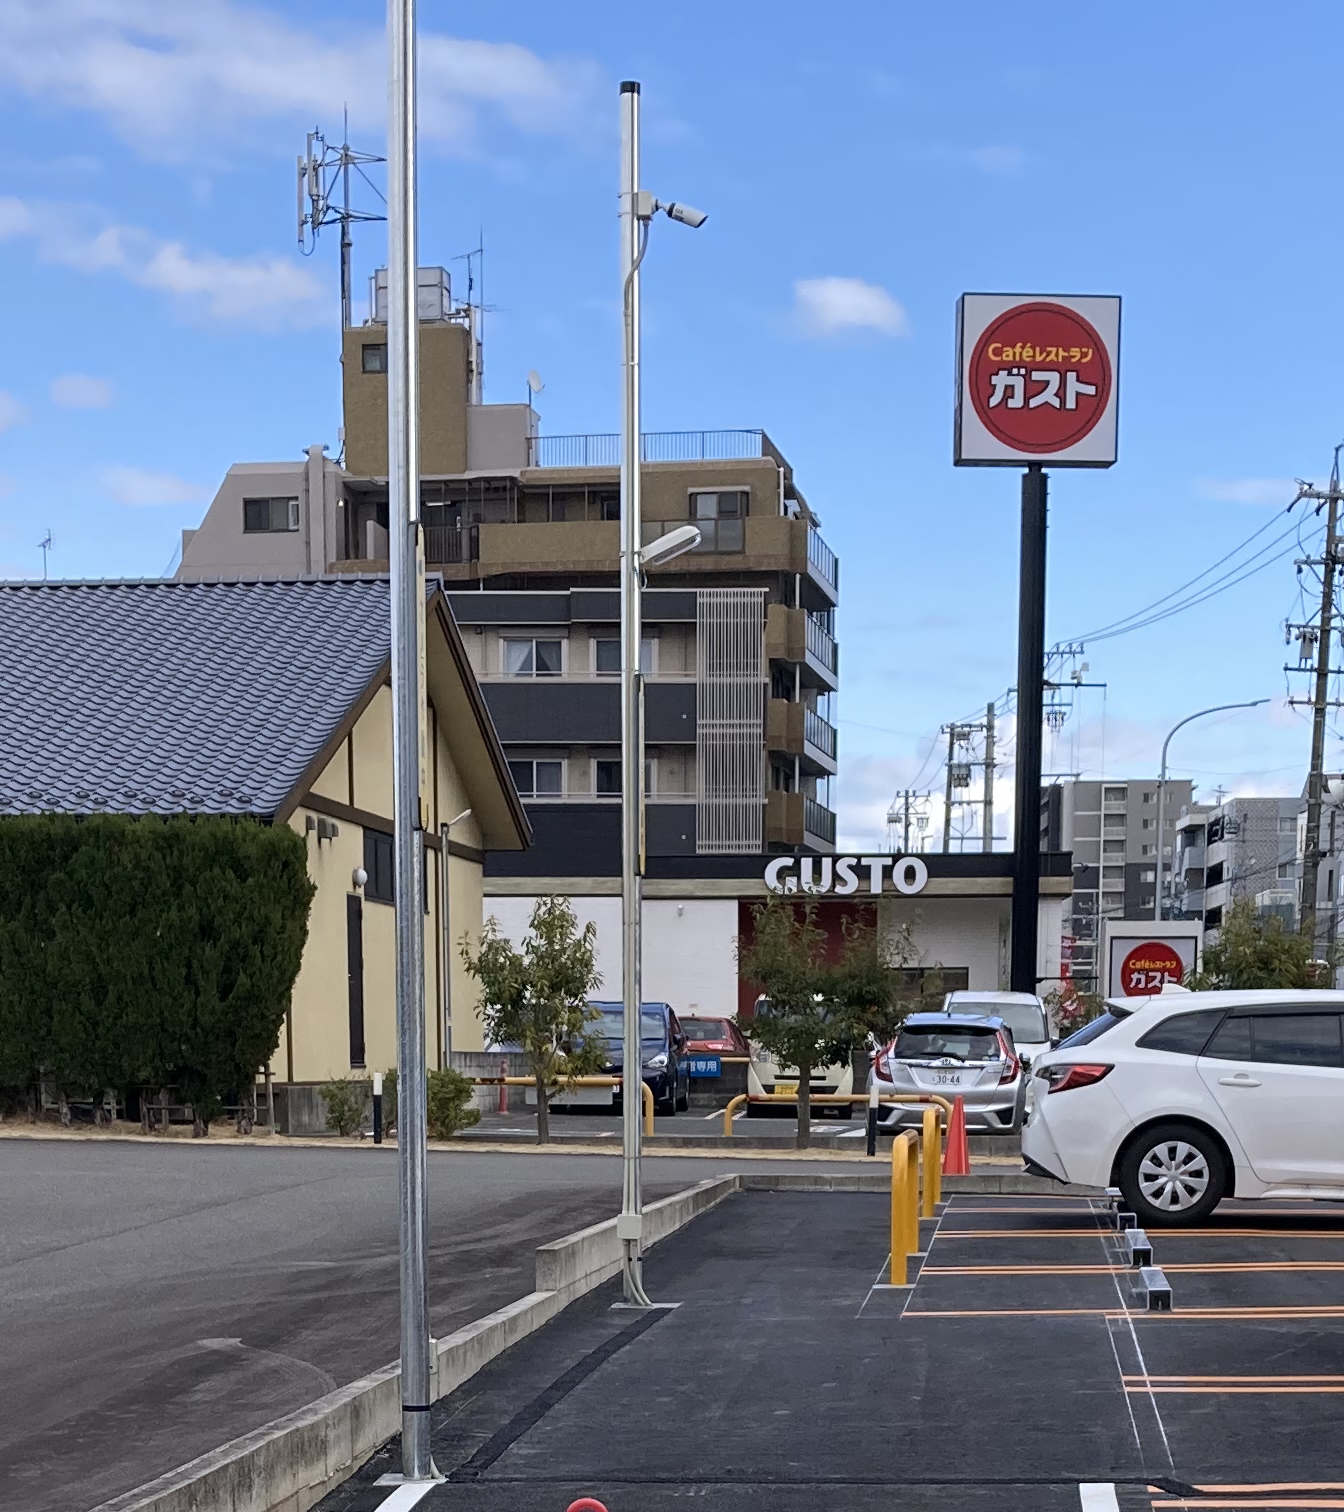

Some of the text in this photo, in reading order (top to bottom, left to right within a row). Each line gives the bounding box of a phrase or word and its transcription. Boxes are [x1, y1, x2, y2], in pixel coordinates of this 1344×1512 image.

[987, 342, 1093, 363] Caféレストラン
[989, 368, 1096, 410] ガスト
[764, 856, 928, 895] GUSTO
[1129, 971, 1178, 989] ガスト
